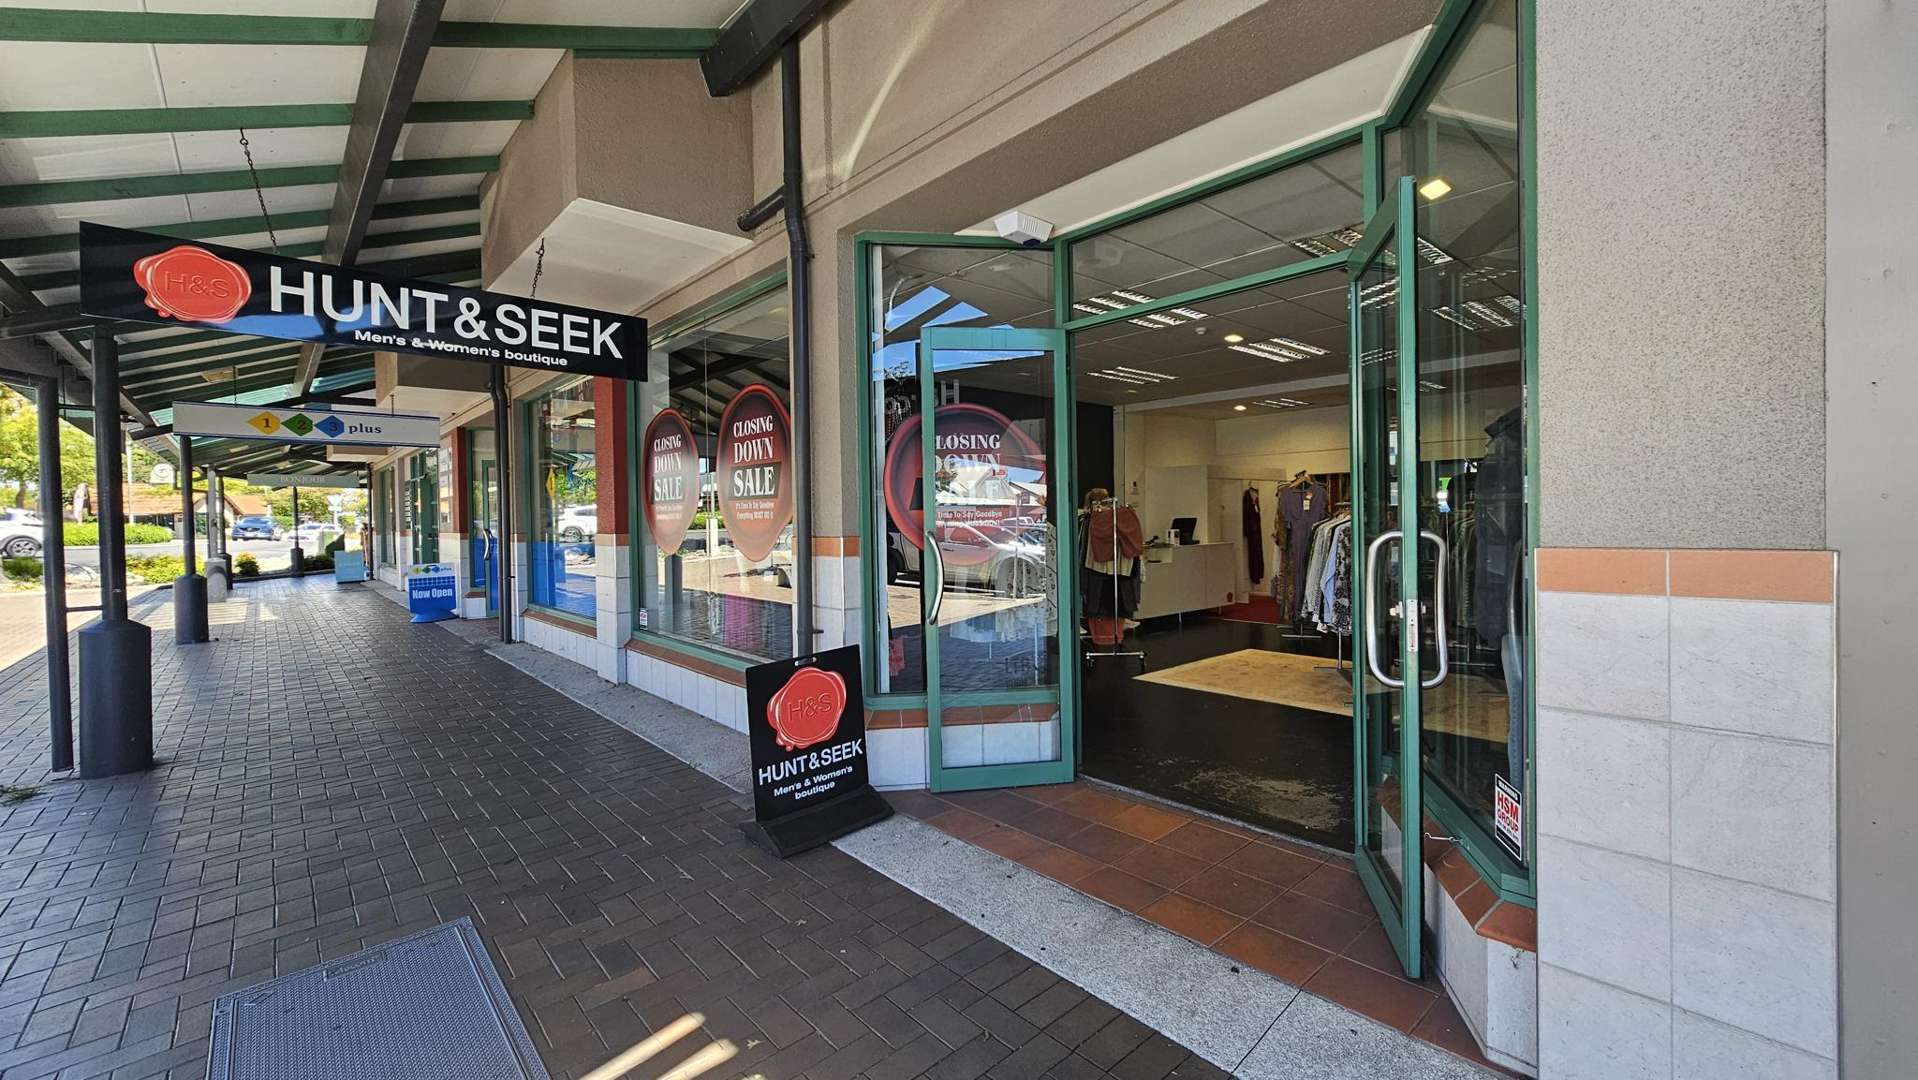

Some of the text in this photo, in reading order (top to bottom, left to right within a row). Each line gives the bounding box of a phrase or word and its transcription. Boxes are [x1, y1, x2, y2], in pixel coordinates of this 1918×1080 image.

[164, 271, 230, 298] H&S
[354, 330, 568, 366] Men's & Women's boutique
[348, 423, 382, 434] plus
[733, 415, 773, 438] CLOSING
[654, 434, 682, 453] CLOSING
[733, 436, 774, 464] DOWN
[935, 434, 1001, 450] LOSING
[654, 452, 682, 474] DOWN
[654, 475, 683, 501] SALE
[733, 466, 775, 497] SALE
[412, 588, 453, 600] Now Open
[788, 692, 831, 723] H&S
[773, 765, 853, 797] Men's & Women's
[794, 781, 836, 800] boutique
[1497, 790, 1519, 824] HSM
[1497, 808, 1519, 832] GROUP
